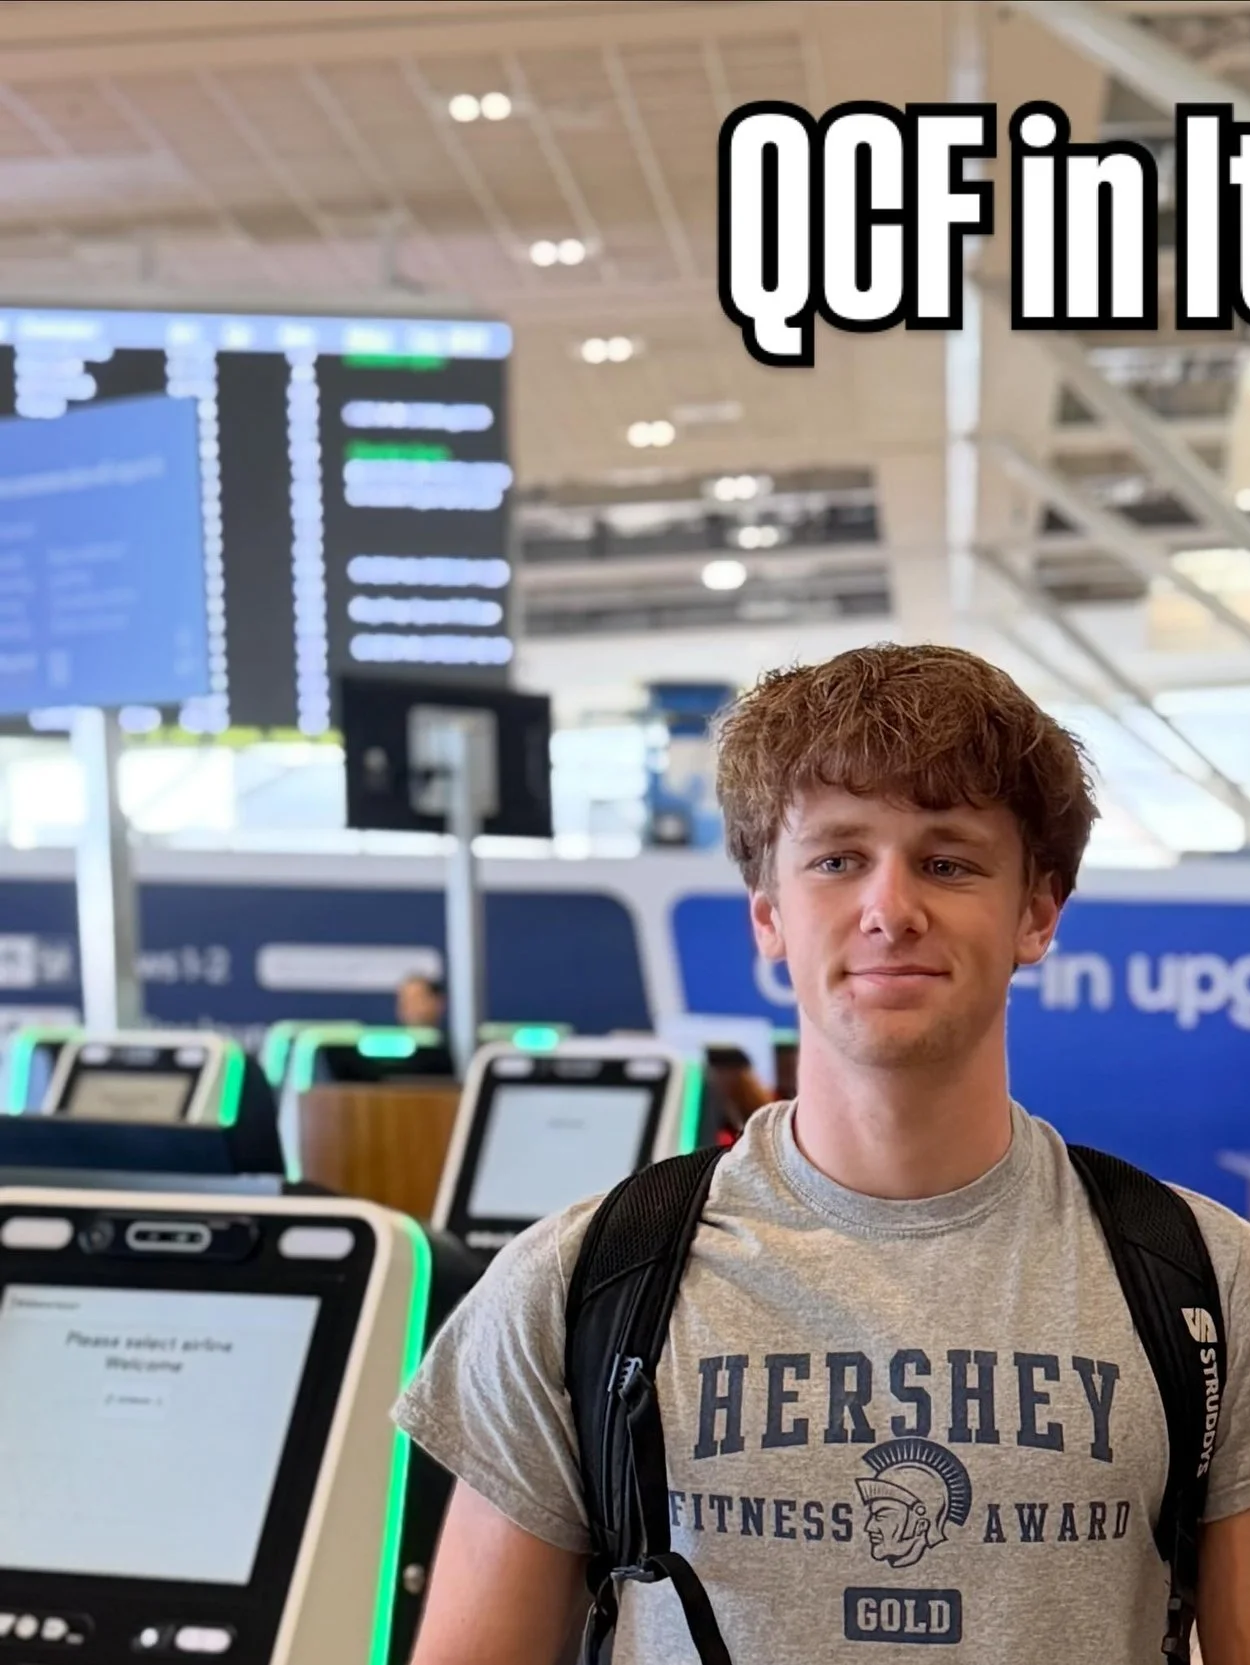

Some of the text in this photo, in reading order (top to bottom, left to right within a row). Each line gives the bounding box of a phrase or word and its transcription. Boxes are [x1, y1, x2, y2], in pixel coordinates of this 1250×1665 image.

[694, 1348, 1121, 1464] HERSHEY
[1196, 1347, 1220, 1479] STRUDDYS
[669, 1490, 1131, 1543] FITNESS AWARD
[856, 1596, 952, 1635] GOLD
